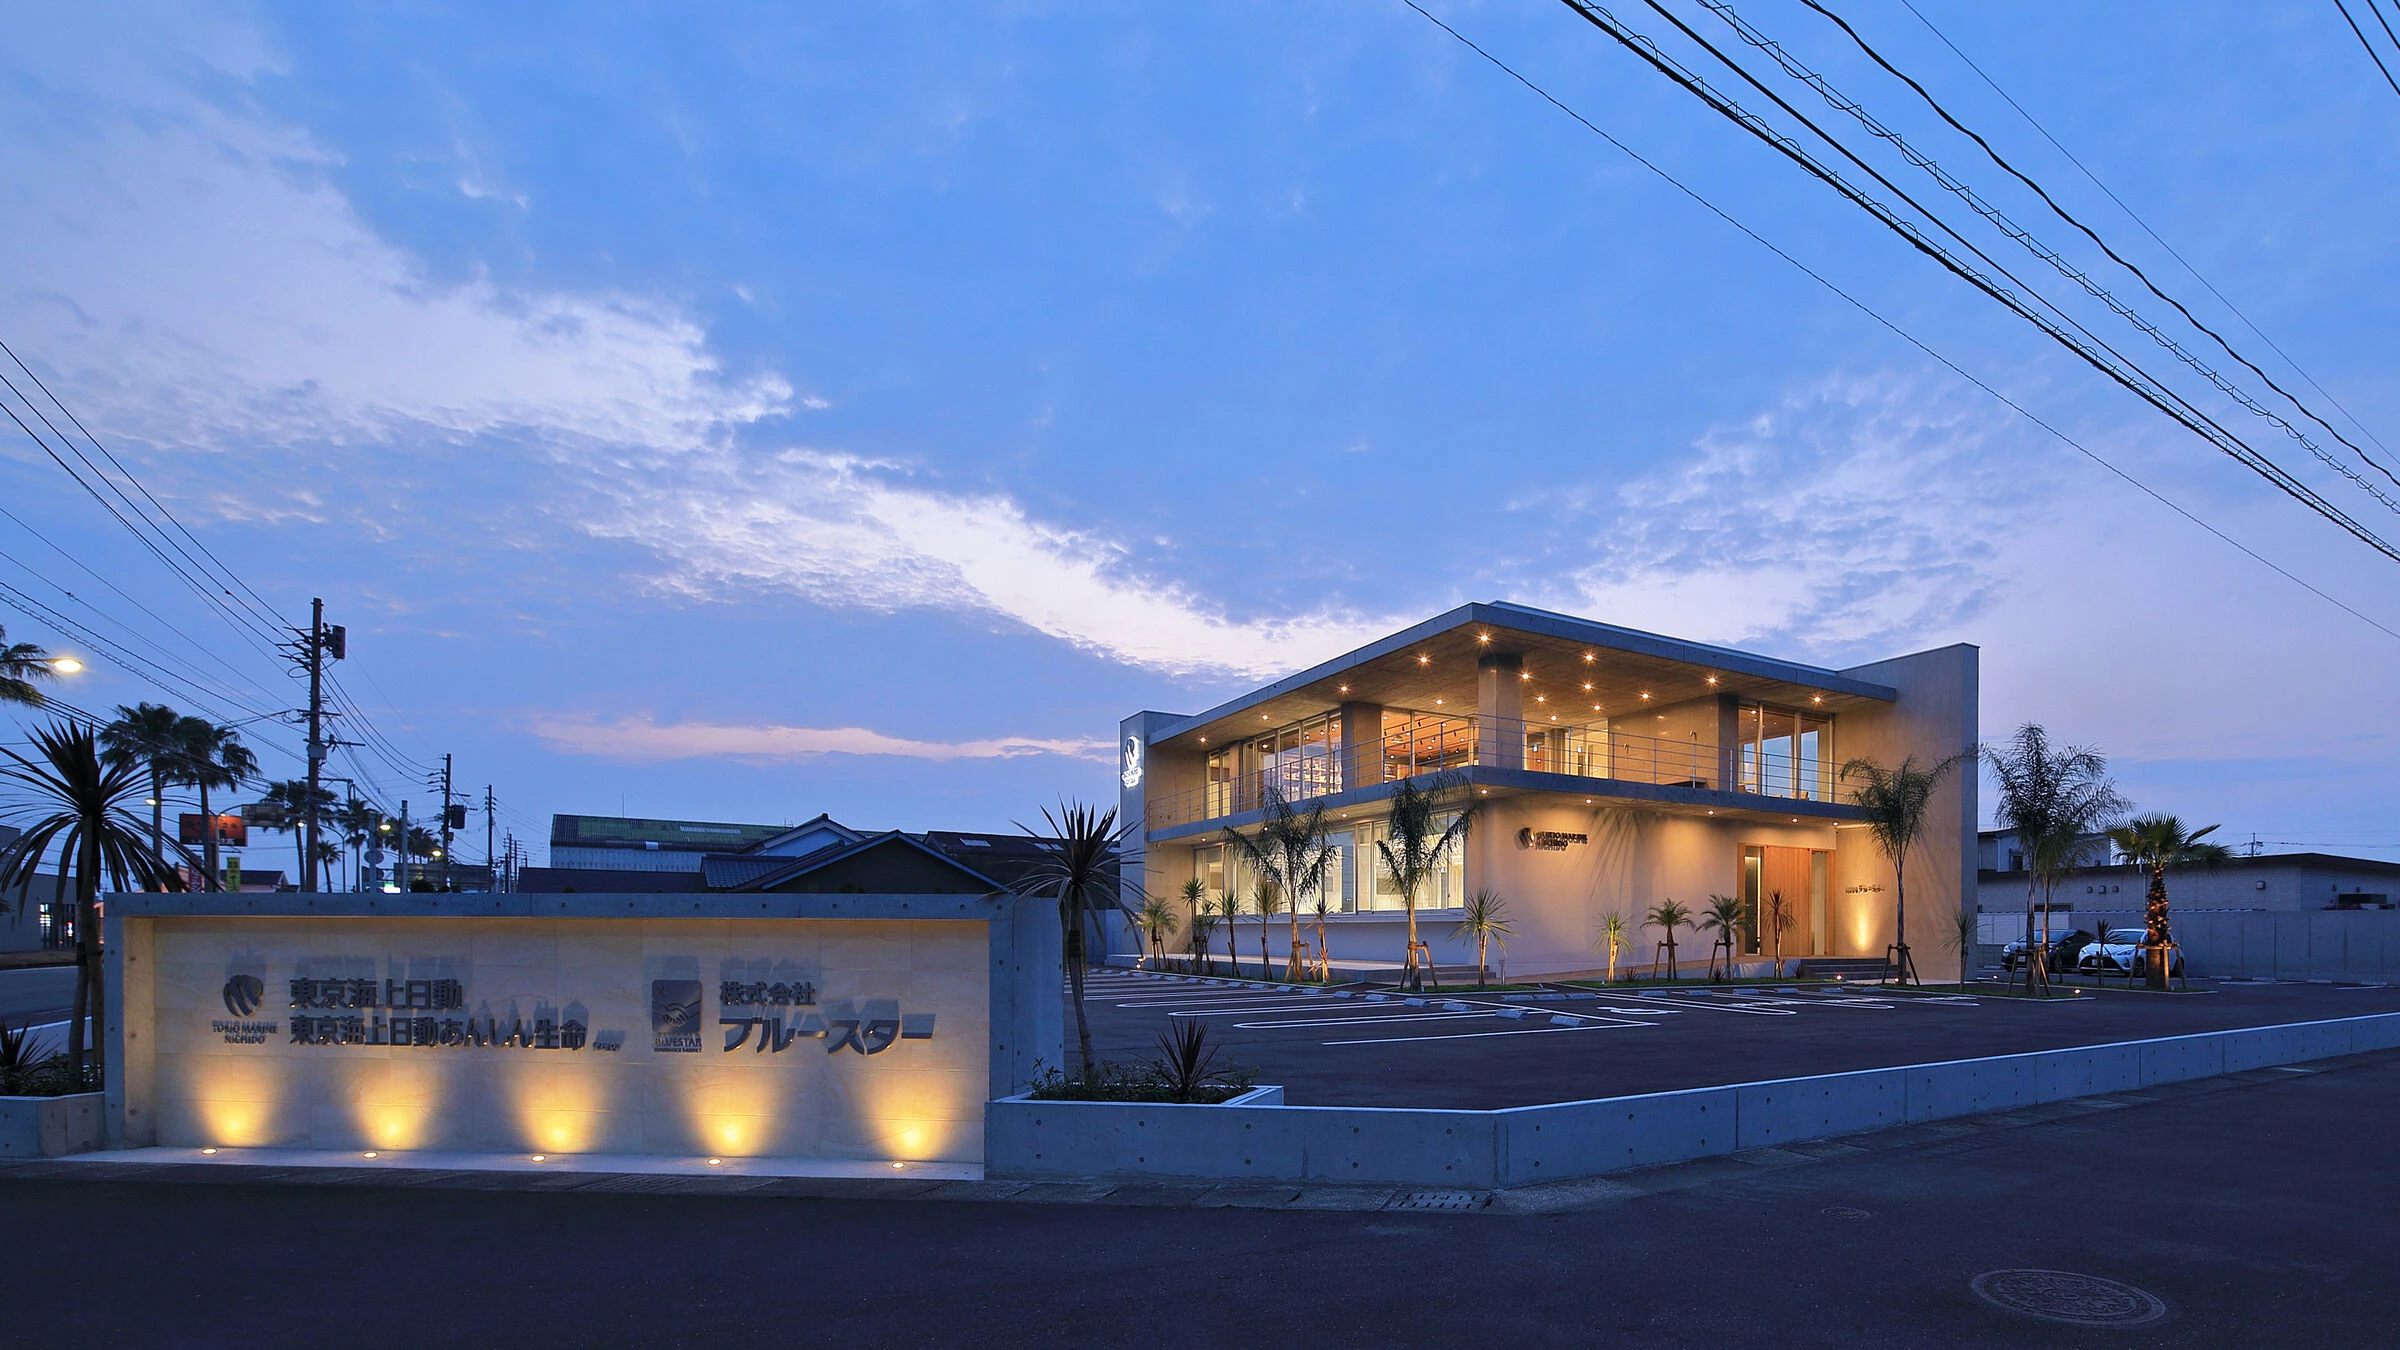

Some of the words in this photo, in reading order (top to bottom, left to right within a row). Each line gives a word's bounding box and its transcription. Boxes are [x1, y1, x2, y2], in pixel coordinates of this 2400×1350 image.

[289, 977, 464, 1010] 東京海上日動
[719, 981, 817, 1006] 株式会社
[211, 1023, 240, 1033] TOKIO
[241, 1023, 279, 1034] MARINE
[224, 1034, 267, 1045] NICHIDO
[289, 1015, 588, 1051] 東京海上日動あんしん生命
[719, 1016, 935, 1056] ブルースター
